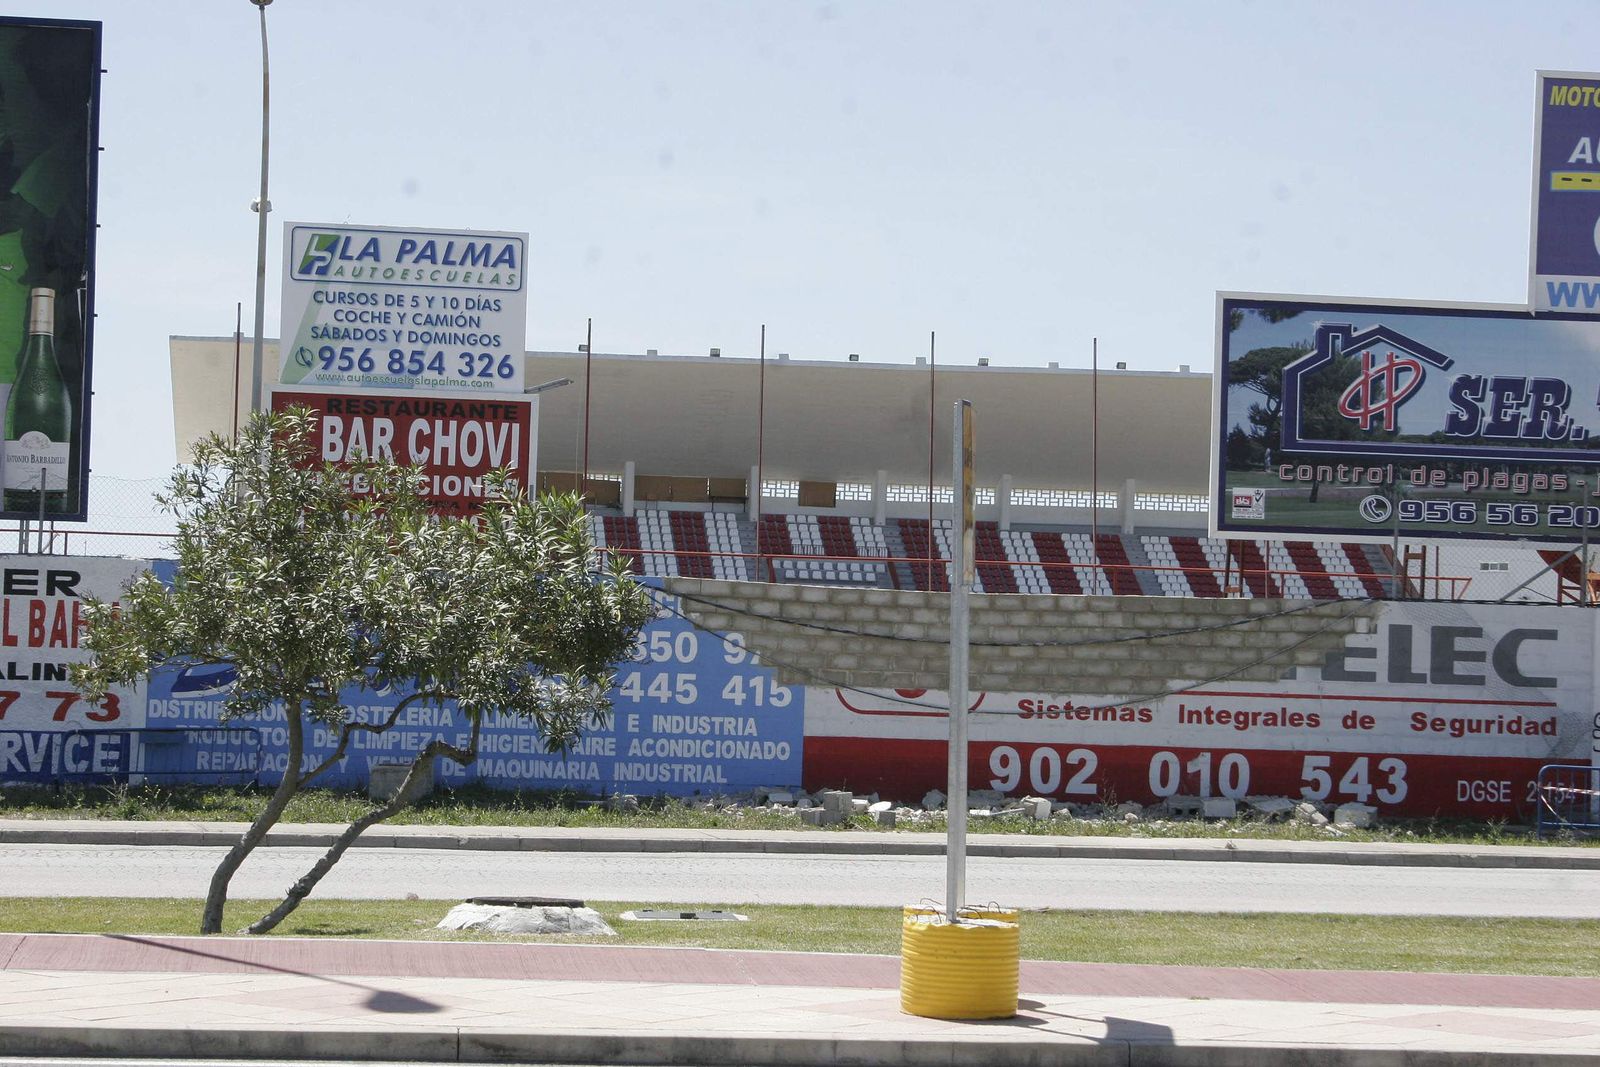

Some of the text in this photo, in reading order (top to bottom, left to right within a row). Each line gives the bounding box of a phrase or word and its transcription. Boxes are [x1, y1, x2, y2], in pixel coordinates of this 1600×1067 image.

[1568, 137, 1600, 164] A
[339, 235, 516, 269] LA PALMA
[334, 265, 517, 286] AUTOESCUELAS
[313, 290, 502, 312] CURSOS DE 5 Y 10 DÍAS
[333, 309, 481, 328] COCHE Y CAMIÓN
[311, 326, 501, 347] SÁBADOS Y DOMINGOS
[318, 345, 515, 379] 956 854 326
[327, 399, 519, 421] RESTAURANTE
[322, 415, 520, 469] BAR CHOVI
[1279, 462, 1394, 484] control
[1410, 465, 1446, 487] de
[1463, 467, 1568, 494] plagas
[1398, 500, 1600, 528] 956 56 20
[4, 568, 81, 597] ER
[28, 599, 121, 648] BAH
[1280, 623, 1558, 689] ELEC
[619, 671, 792, 707] 445 415
[46, 691, 121, 722] 73
[149, 699, 289, 722] DISTRIBION
[338, 704, 453, 727] OSTELERIA
[627, 713, 639, 735] E
[652, 714, 757, 737] INDUSTRIA
[1016, 698, 1557, 738] Sistemas Integrales de Seguridad
[176, 725, 291, 747] RODUCTO
[313, 728, 339, 748] DE
[479, 733, 557, 756] HIGIEN
[571, 736, 617, 756] AIRE
[628, 739, 790, 761] ACONDICIONADO
[197, 751, 323, 773] REPARACON
[441, 757, 466, 777] DE
[476, 759, 600, 781] MAQUINARIA
[613, 762, 727, 784] INDUSTRIAL
[989, 745, 1409, 805] 902 010 543
[1457, 779, 1512, 802] DGSE
